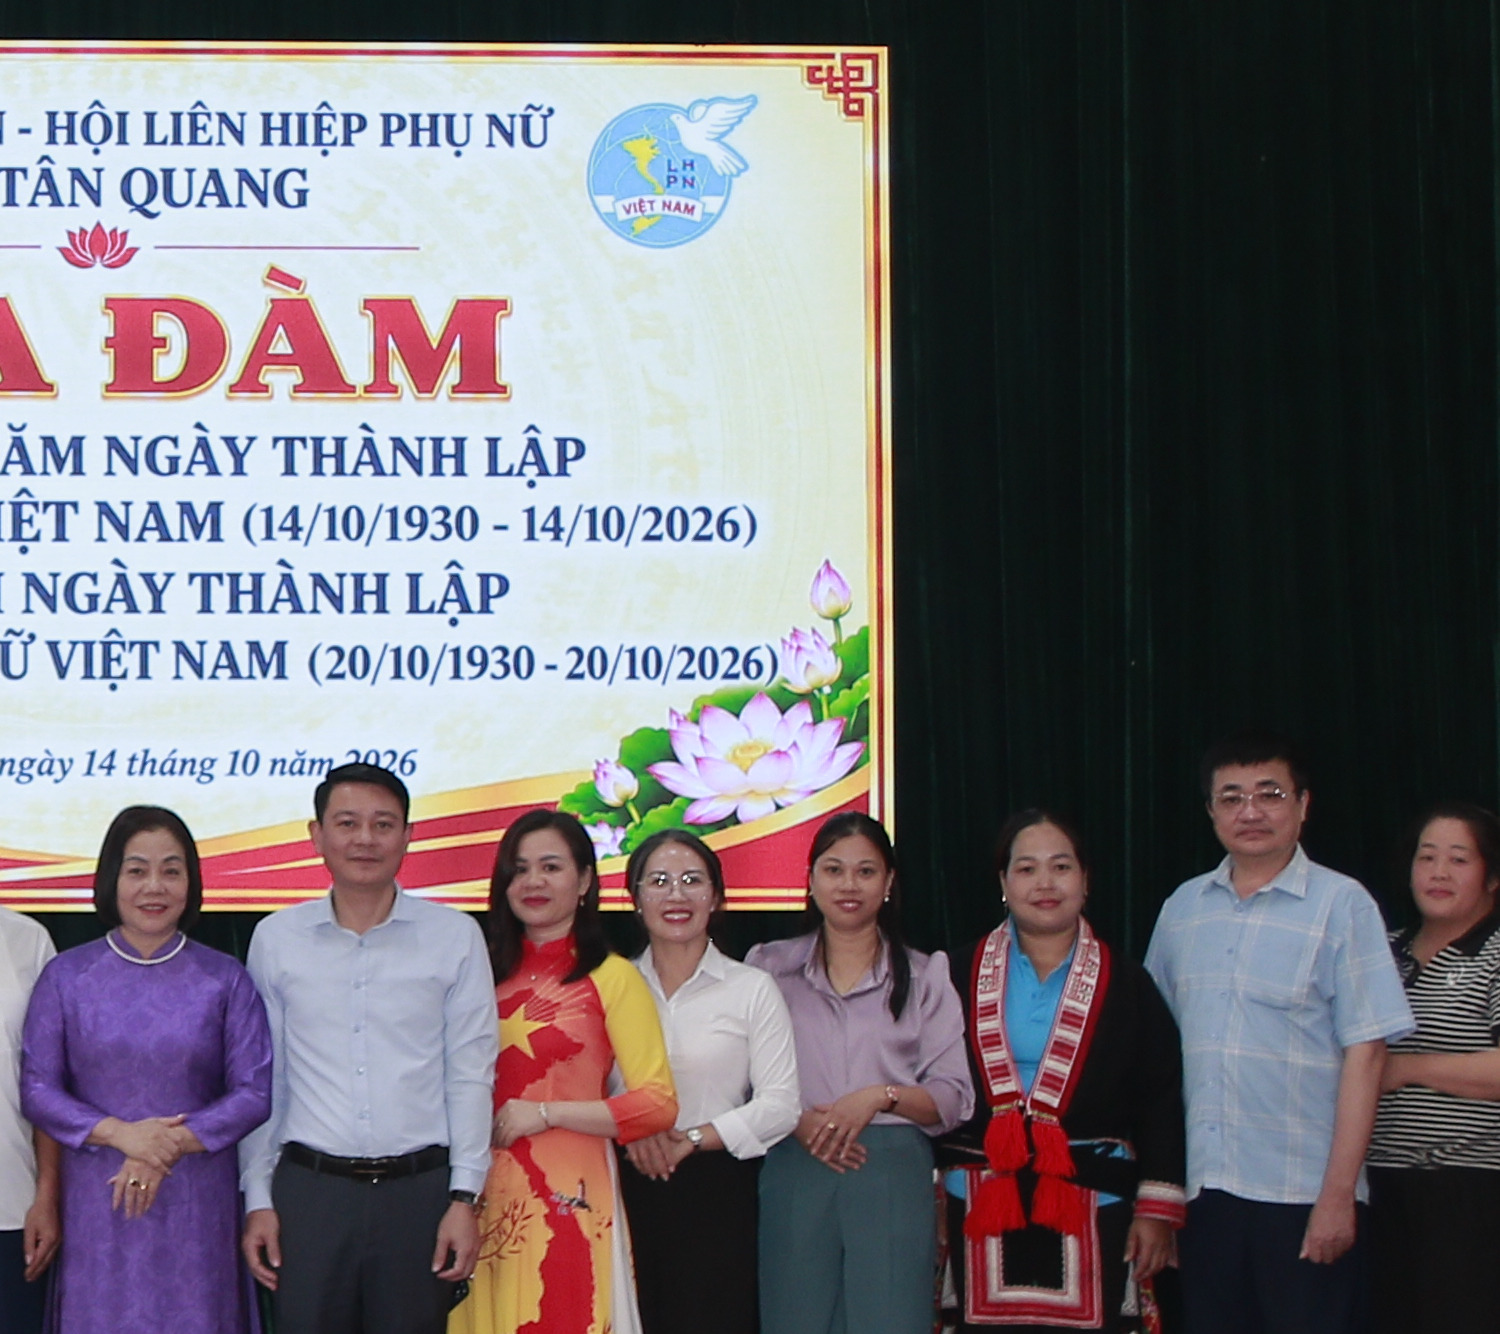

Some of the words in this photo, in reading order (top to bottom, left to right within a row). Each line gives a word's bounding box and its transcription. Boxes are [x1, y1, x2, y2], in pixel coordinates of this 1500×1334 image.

[45, 99, 130, 156] HỘI
[143, 99, 247, 147] LIÊN
[260, 100, 368, 157] HIỆP
[380, 112, 473, 157] PHỤ
[485, 103, 555, 149] NỮ
[119, 166, 310, 220] QUANG
[662, 200, 696, 216] NAM
[102, 263, 511, 398] ĐÀM
[103, 421, 258, 477] NGÀY
[271, 422, 468, 478] THÀNH
[484, 423, 587, 489] LẬP
[94, 500, 225, 543] NAM
[242, 502, 480, 547] (14/10/1930
[523, 504, 758, 548] 14/10/2026)
[21, 558, 176, 615] NGÀY
[187, 558, 390, 615] THÀNH
[405, 559, 511, 628] LẬP
[45, 627, 160, 692] VIỆT
[172, 640, 288, 680] NAM
[308, 643, 535, 685] (20/10/1930
[566, 645, 780, 692] 20/10/2026)
[84, 748, 114, 777] 14
[126, 748, 216, 785] tháng
[226, 748, 258, 777] 10
[269, 750, 334, 777] năm
